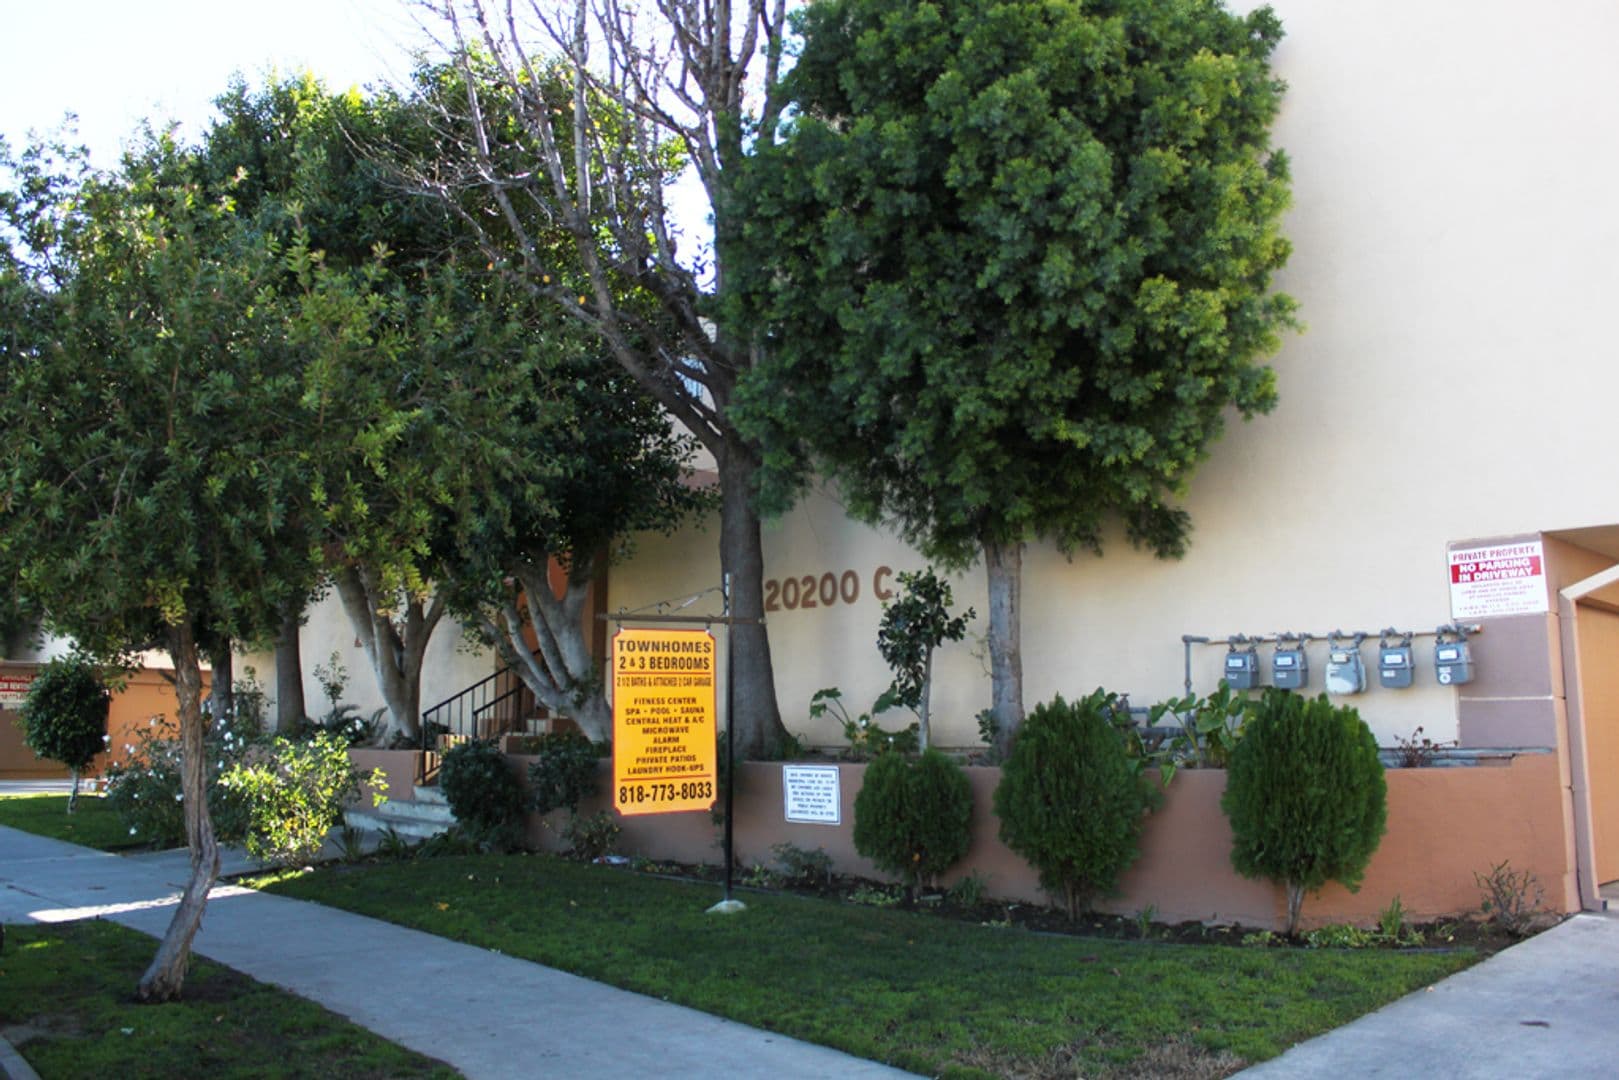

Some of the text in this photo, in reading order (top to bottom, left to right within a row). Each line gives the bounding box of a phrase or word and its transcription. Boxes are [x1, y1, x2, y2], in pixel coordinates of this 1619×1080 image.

[1453, 546, 1535, 561] PRIVATE PROPERTY
[1460, 558, 1530, 573] NO PARKING
[1459, 567, 1533, 582] IN DRIVEWAY
[764, 569, 860, 612] 20200
[617, 640, 711, 653] TOWNHOMES
[619, 656, 626, 669] 2
[639, 656, 646, 669] 3
[649, 656, 710, 670] BEDROOMS
[633, 697, 665, 705] FITNESS
[650, 707, 670, 715] POOL
[625, 717, 661, 726] CENTRAL
[663, 716, 682, 725] HEAT
[642, 726, 689, 734] MICROWAVE
[645, 746, 687, 754] FIREPLACE
[636, 755, 696, 764] PRIVATE PATIOS
[627, 764, 704, 775] LAUNDRY HOOK-UPS
[619, 782, 712, 804] 818-773-8033
